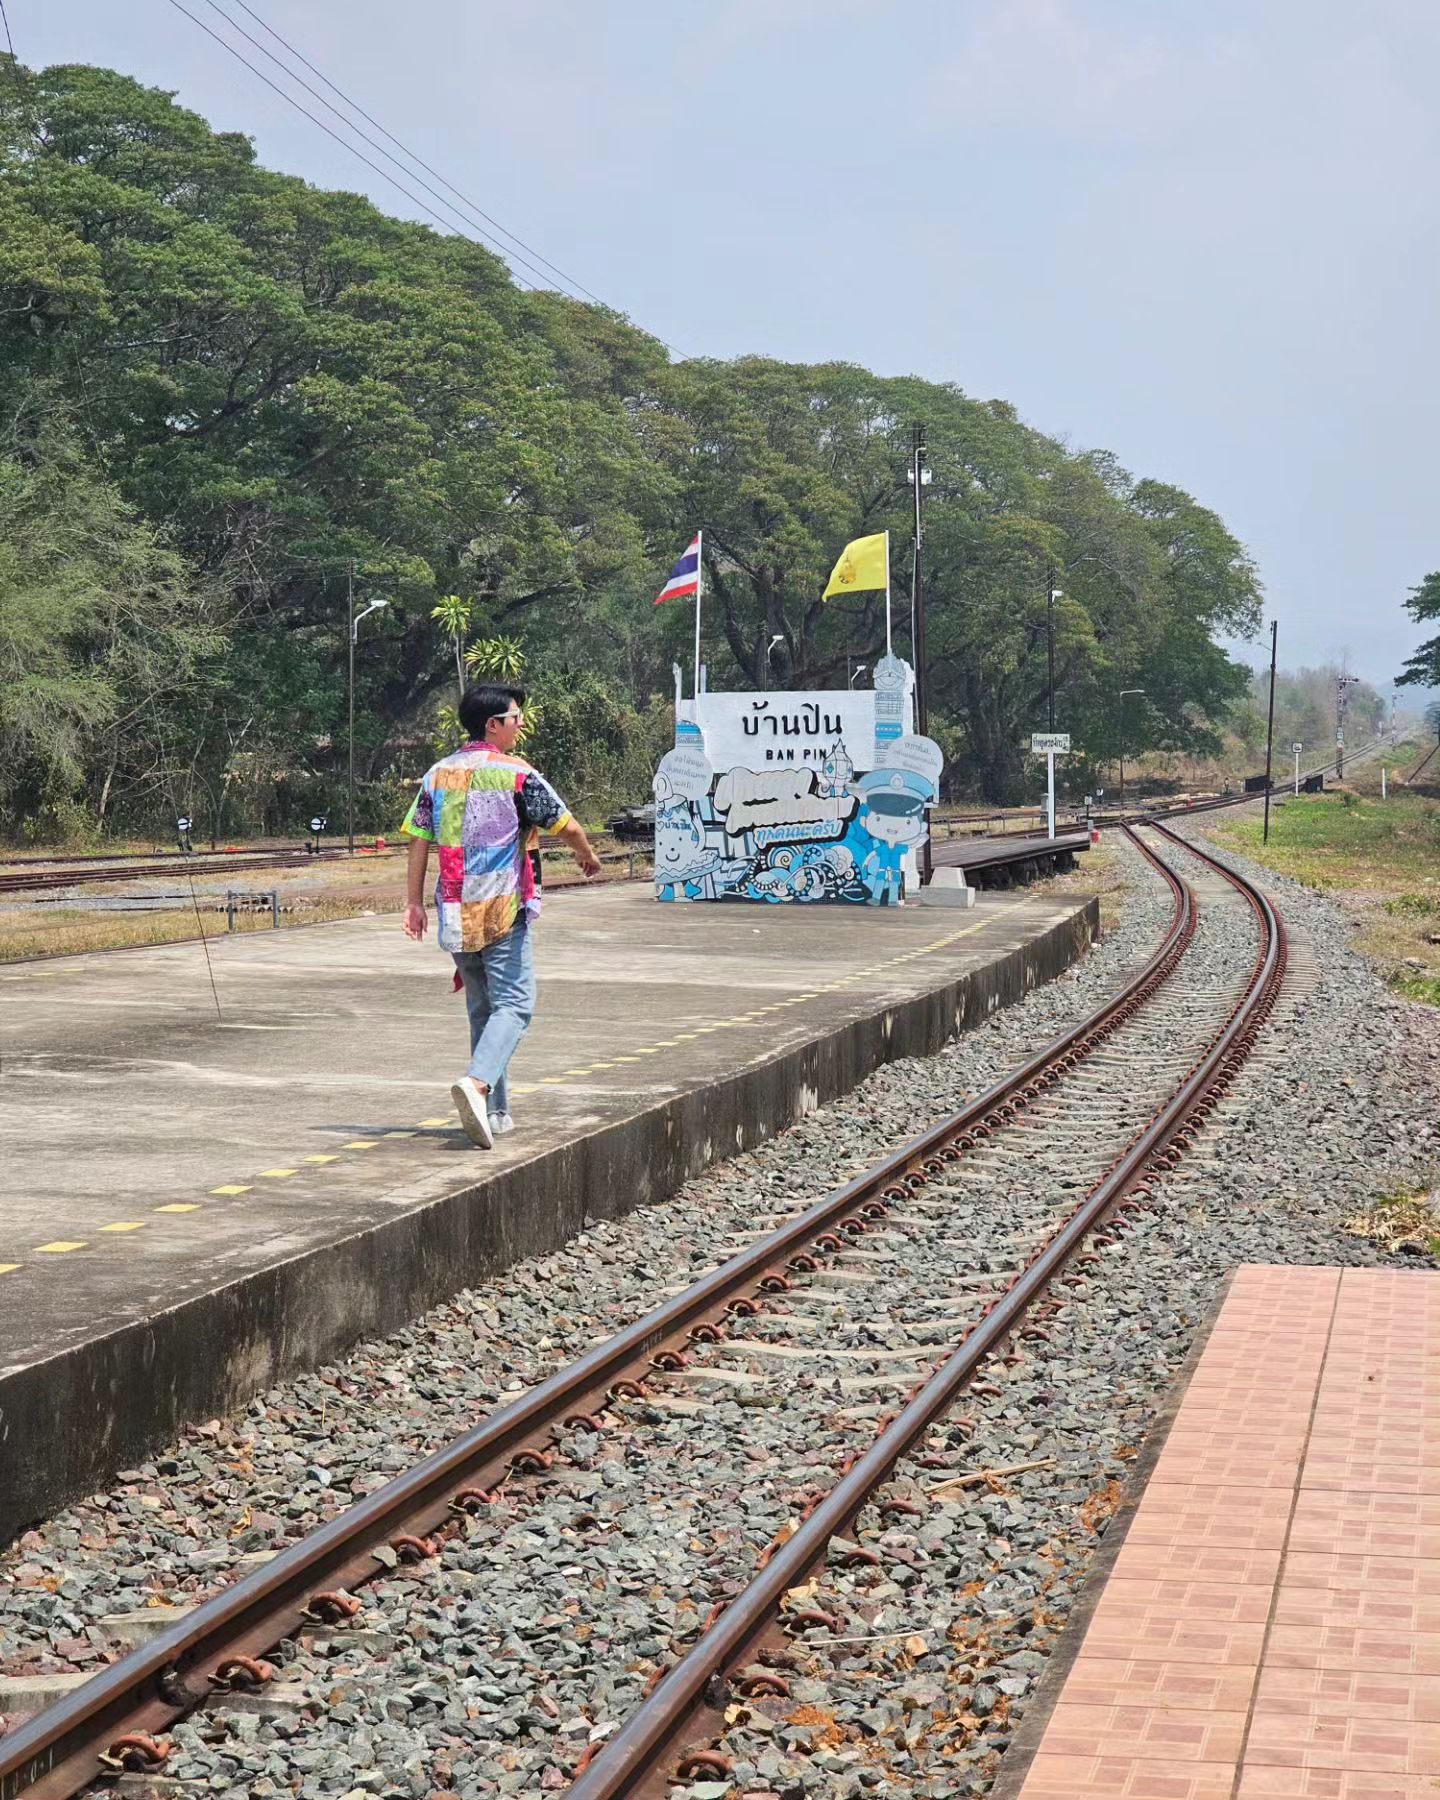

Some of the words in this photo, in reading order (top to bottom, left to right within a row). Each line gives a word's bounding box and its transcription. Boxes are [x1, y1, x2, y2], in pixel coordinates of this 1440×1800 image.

[742, 701, 843, 735] บ้านปิน
[766, 749, 794, 760] BAN
[803, 749, 827, 760] PIN
[757, 819, 840, 844] ทุกคนนะครับ
